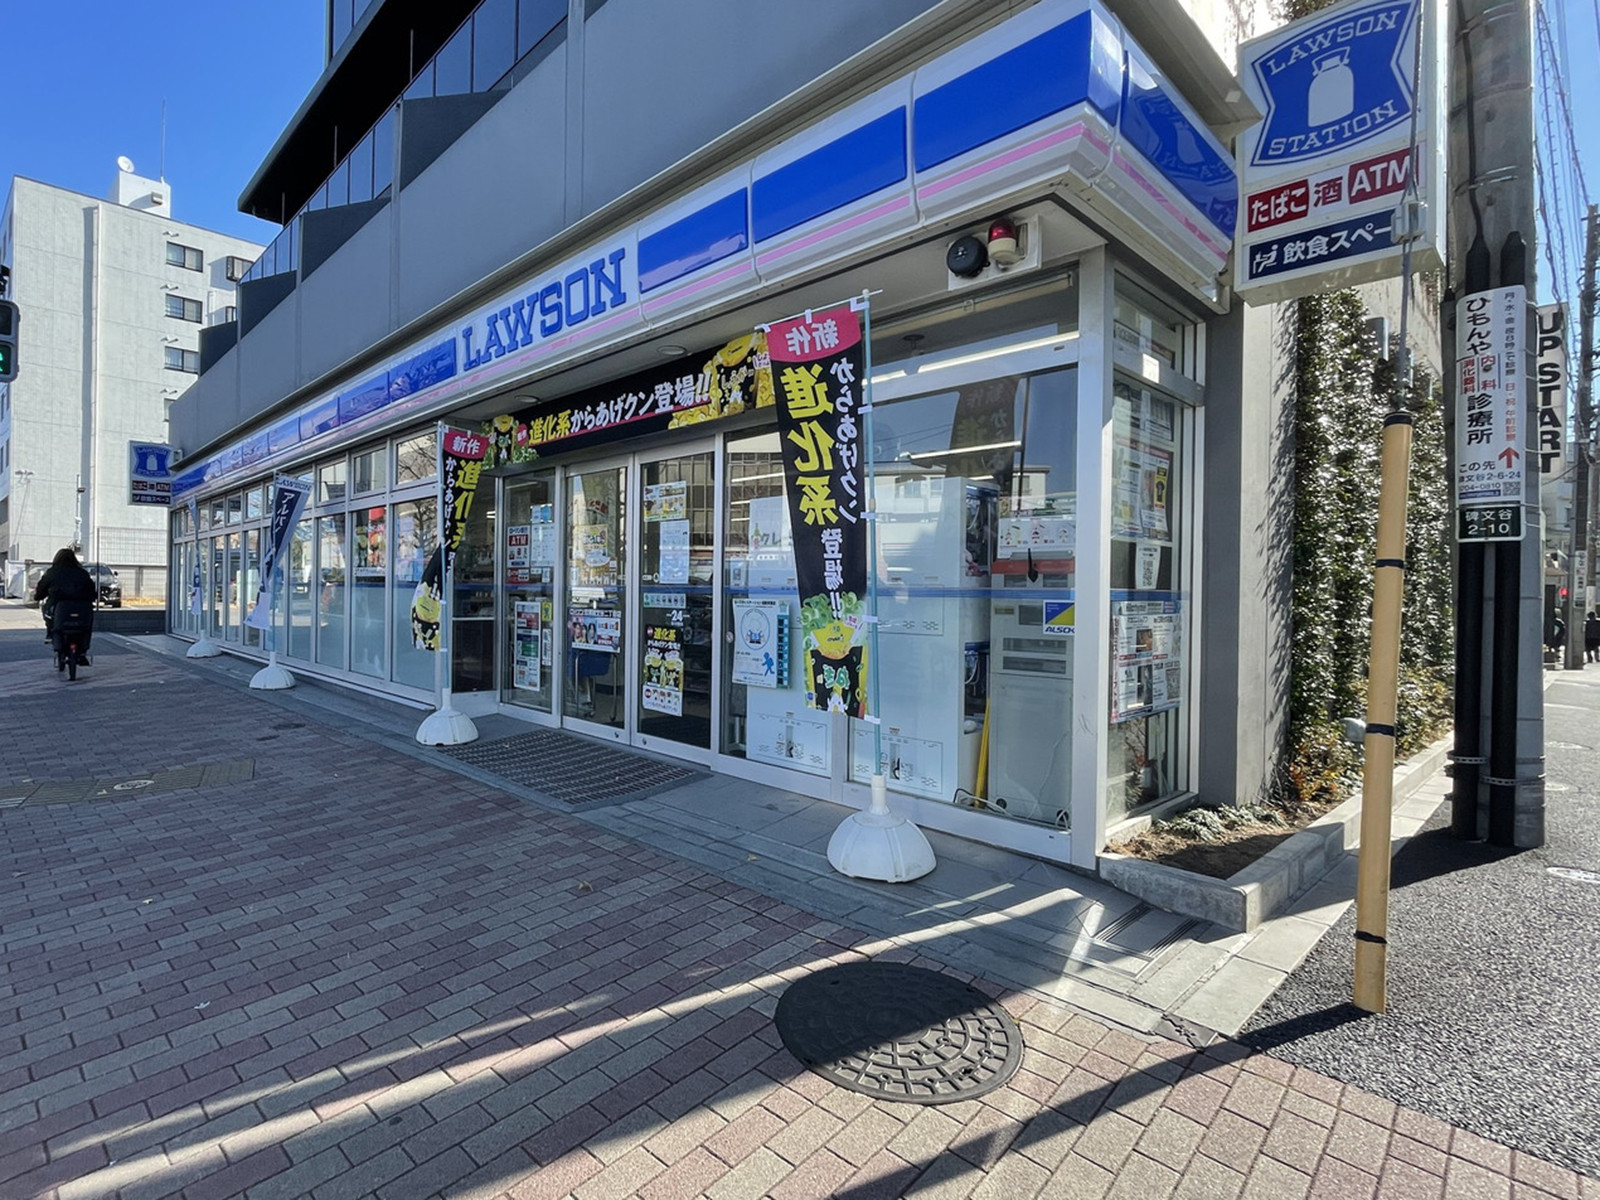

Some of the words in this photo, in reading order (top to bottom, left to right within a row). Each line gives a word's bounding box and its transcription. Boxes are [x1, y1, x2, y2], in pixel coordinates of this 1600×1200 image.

[1267, 9, 1400, 77] LAWSON
[1268, 99, 1398, 156] STATION
[1250, 188, 1308, 225] たばこ
[1313, 176, 1343, 208] 酒
[1351, 156, 1411, 197] ATM
[1283, 218, 1392, 263] 飲食スペー
[462, 247, 627, 371] LAWSON
[1467, 297, 1491, 356] ひもんや
[1539, 312, 1564, 357] UP
[1467, 393, 1493, 445] 診療所
[1539, 363, 1562, 473] START
[452, 436, 481, 455] 新作
[1460, 461, 1496, 473] この先
[1468, 523, 1510, 535] 2-10
